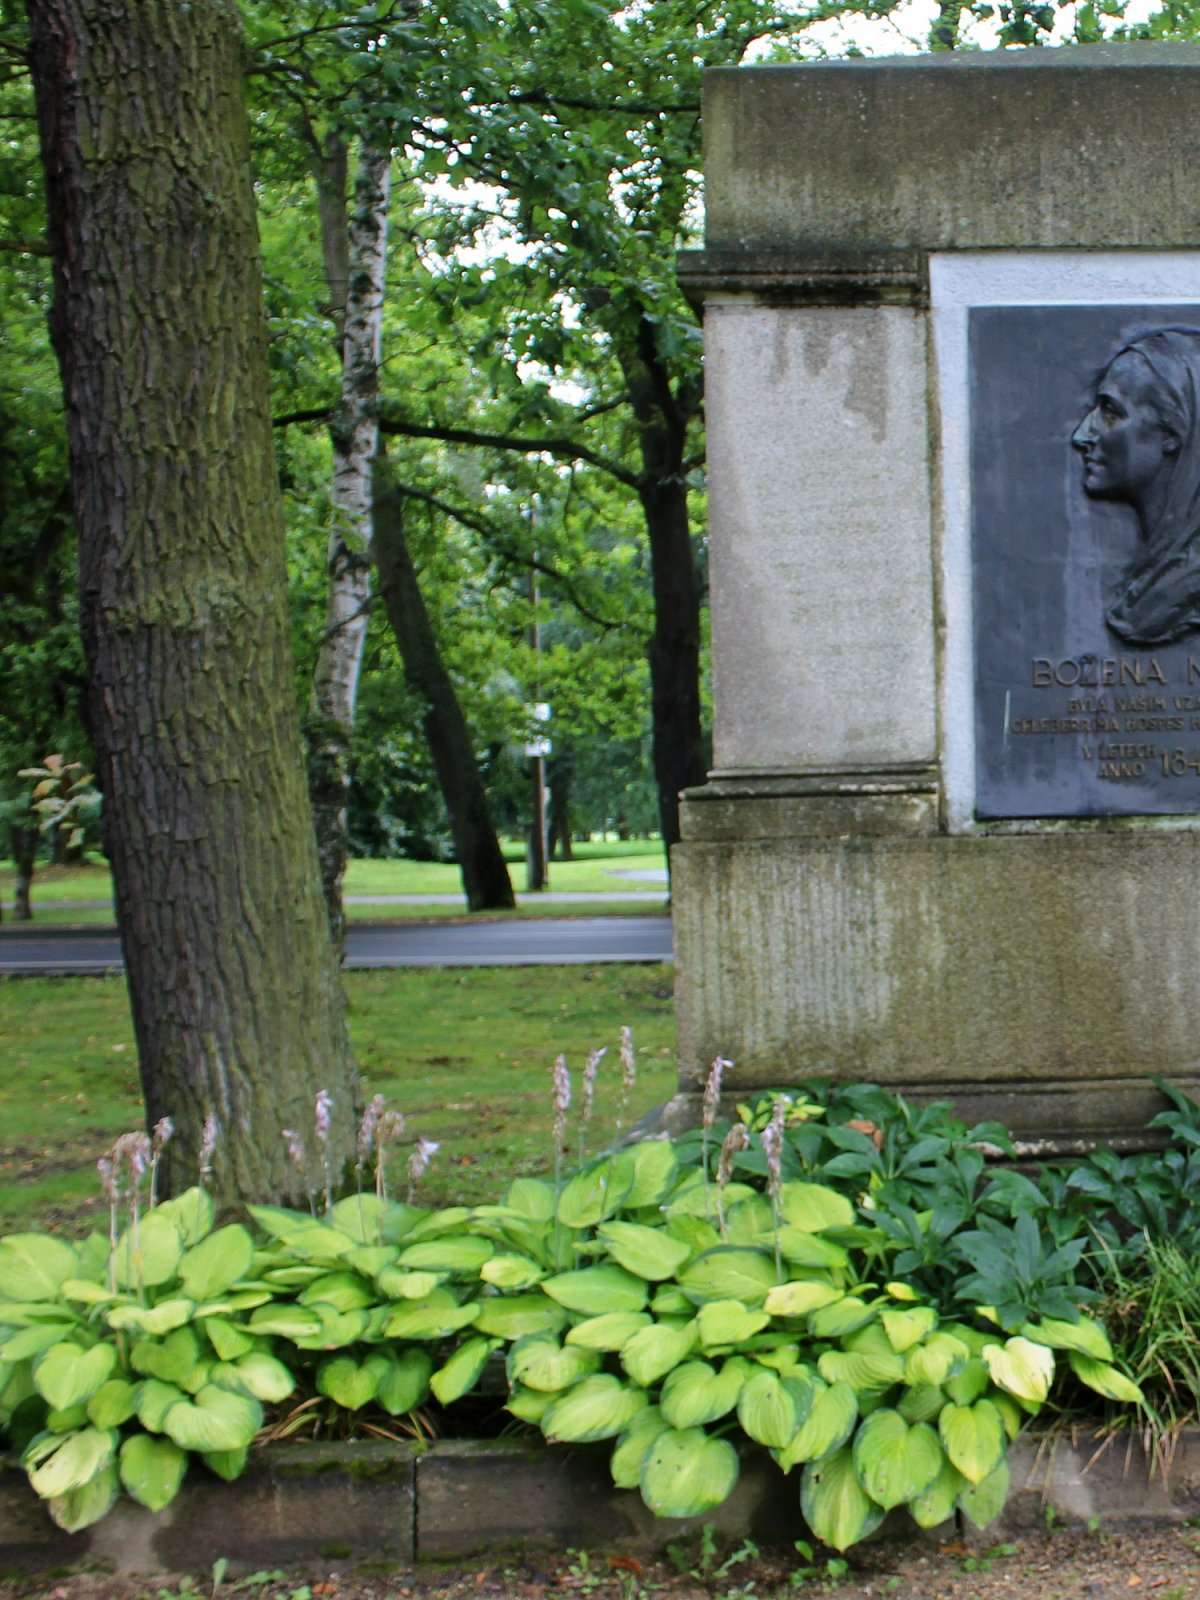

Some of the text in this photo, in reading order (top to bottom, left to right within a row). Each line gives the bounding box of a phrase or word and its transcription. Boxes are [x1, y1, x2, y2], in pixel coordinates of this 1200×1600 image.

[1032, 654, 1167, 687] BOŽENA
[1068, 698, 1108, 713] BYLA
[1125, 716, 1184, 731] HOSPES
[1097, 762, 1145, 778] ANNO
